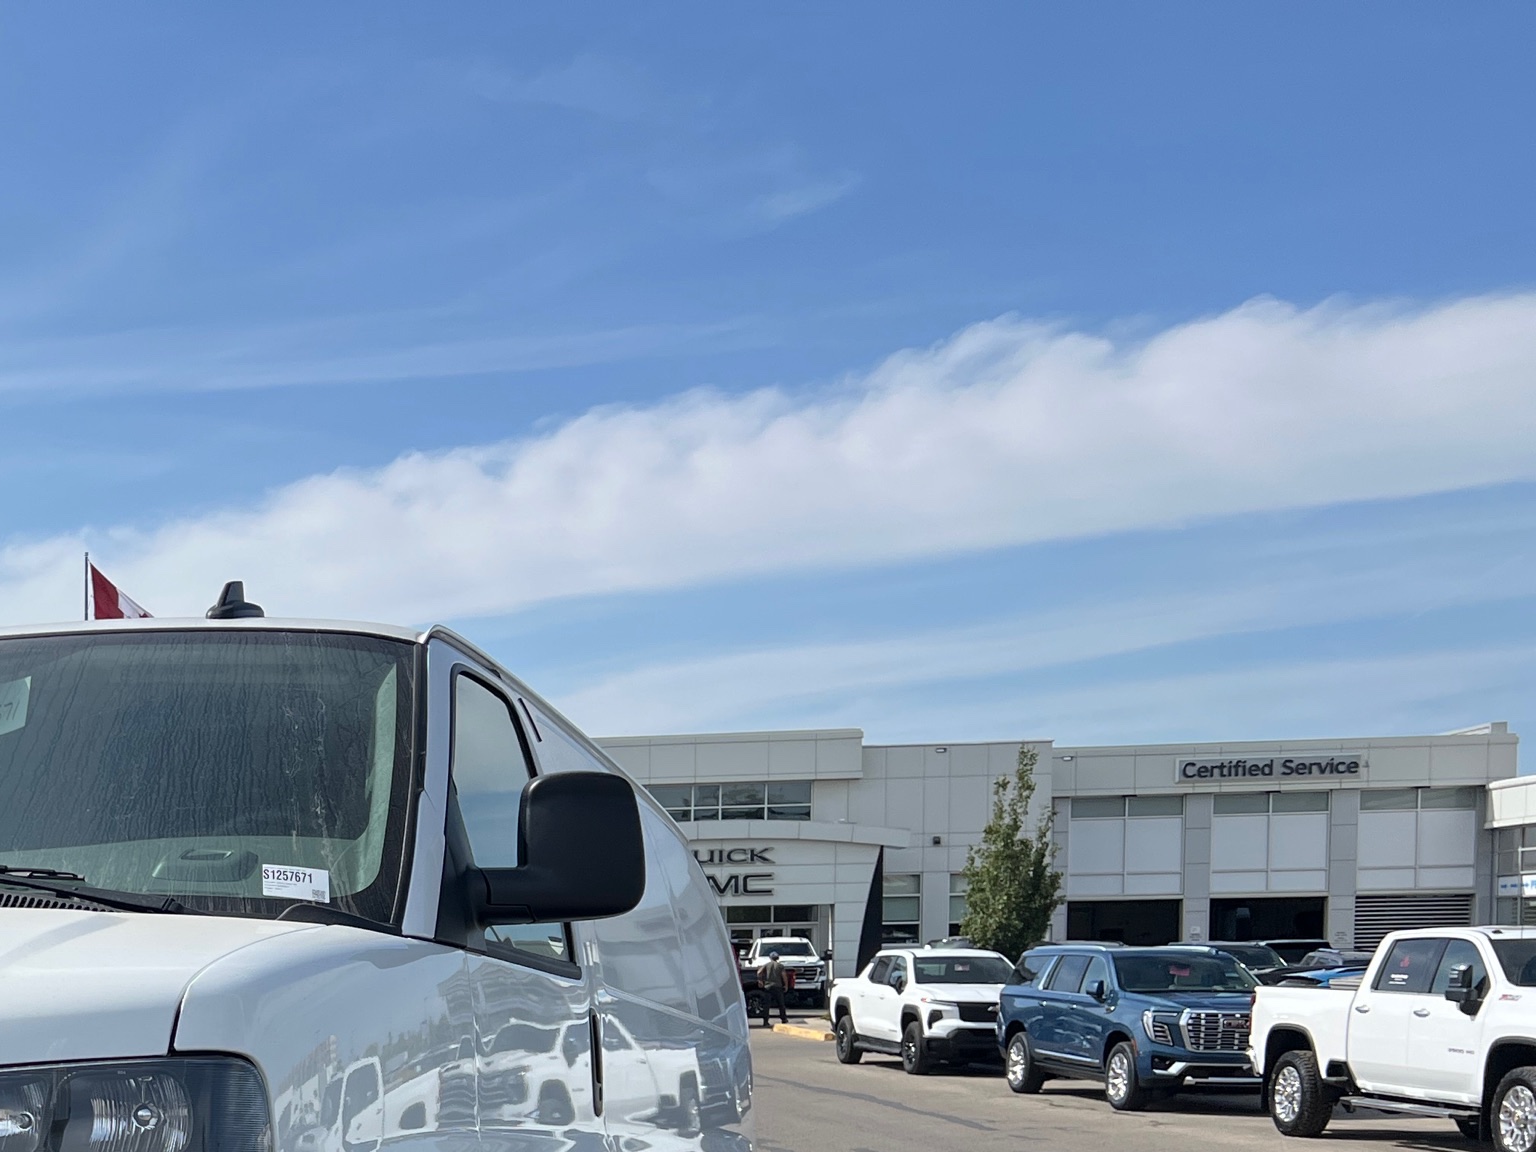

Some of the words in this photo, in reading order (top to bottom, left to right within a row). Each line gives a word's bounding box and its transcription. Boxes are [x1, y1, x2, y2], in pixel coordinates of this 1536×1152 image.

[1182, 759, 1274, 779] Certified
[1281, 757, 1360, 776] Service
[691, 847, 776, 864] UICK
[263, 868, 313, 884] S1257671
[706, 873, 775, 897] MC
